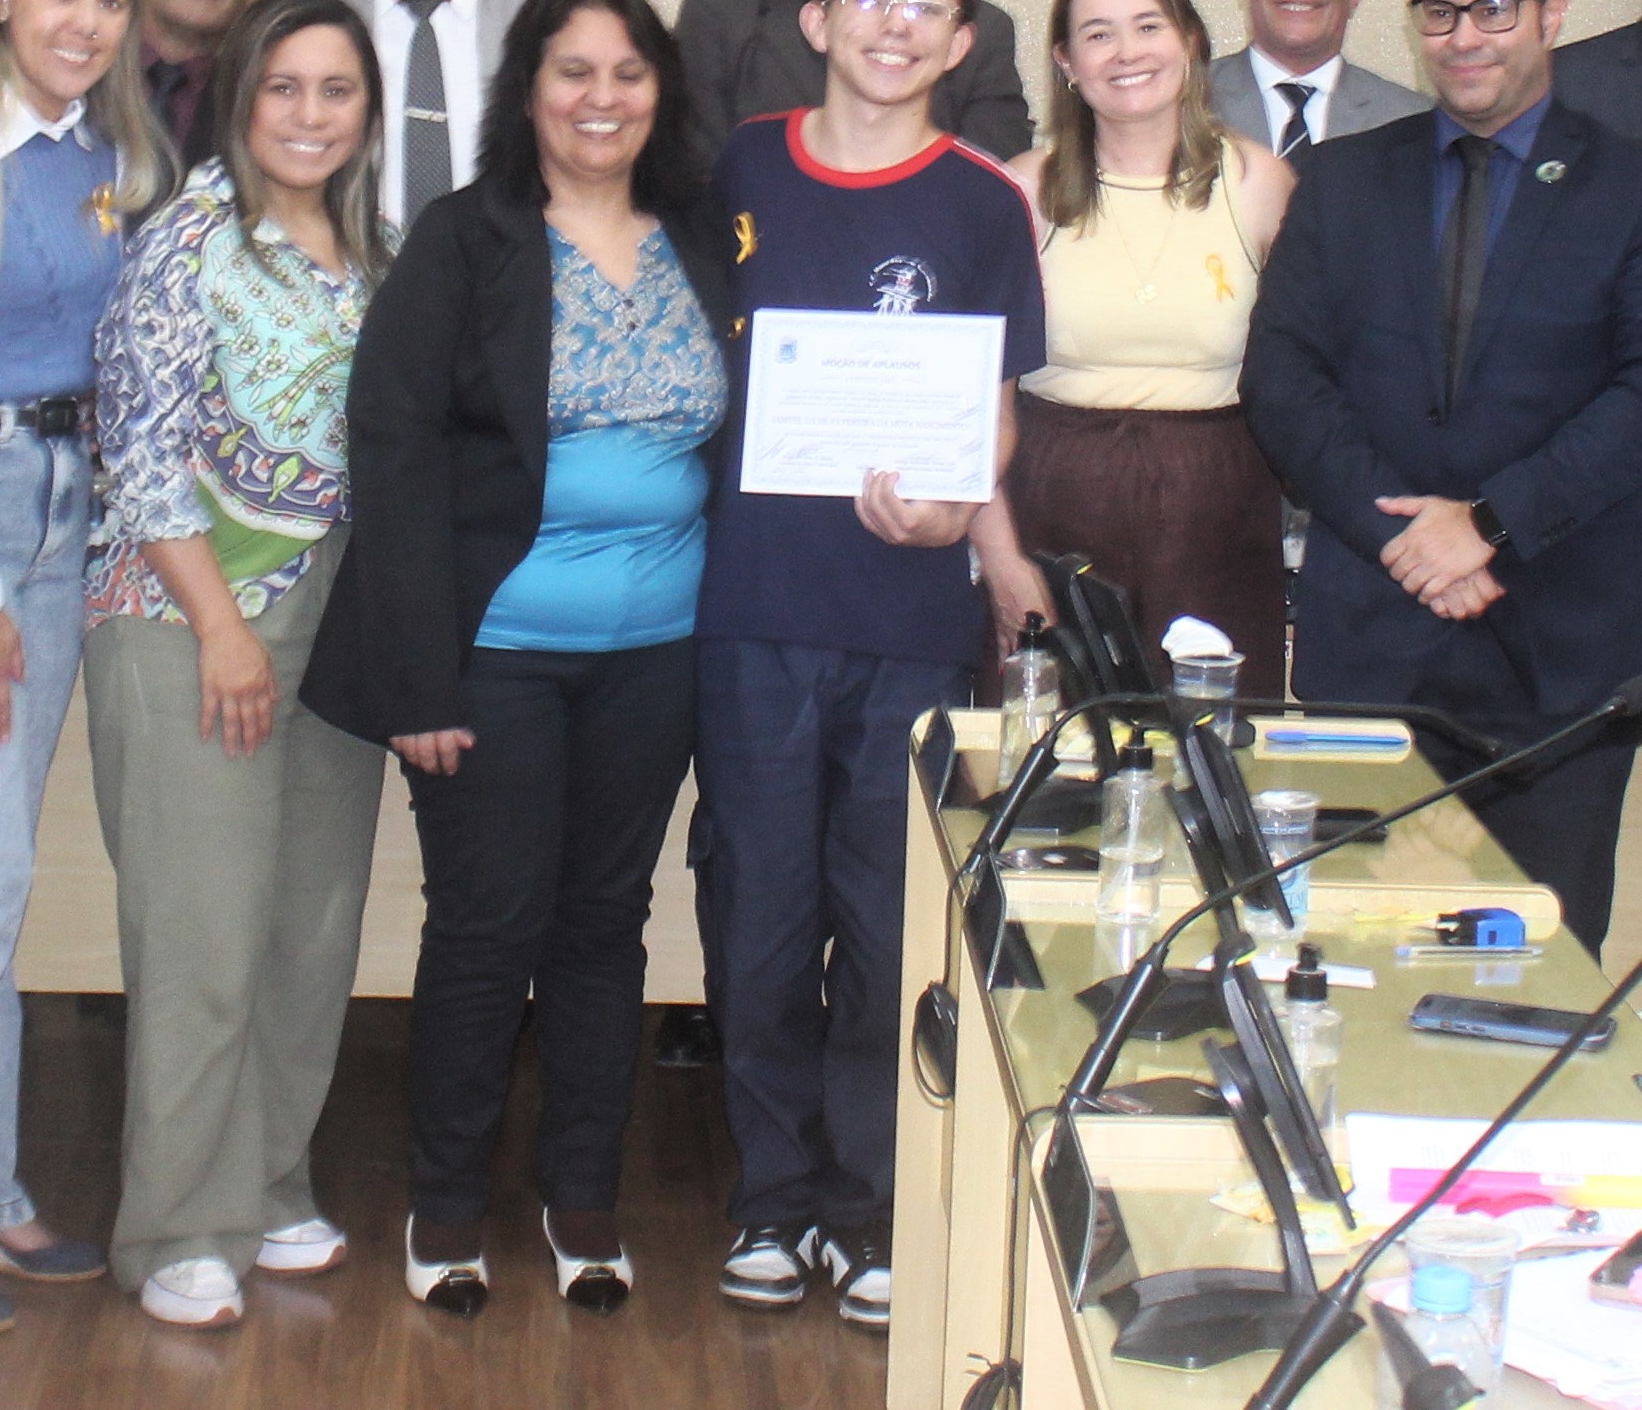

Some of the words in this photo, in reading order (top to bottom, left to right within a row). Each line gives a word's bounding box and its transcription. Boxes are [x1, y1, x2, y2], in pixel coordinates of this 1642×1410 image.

[821, 358, 856, 370] MOÇÃO
[857, 359, 870, 369] DE
[872, 359, 921, 370] APLAUSOS
